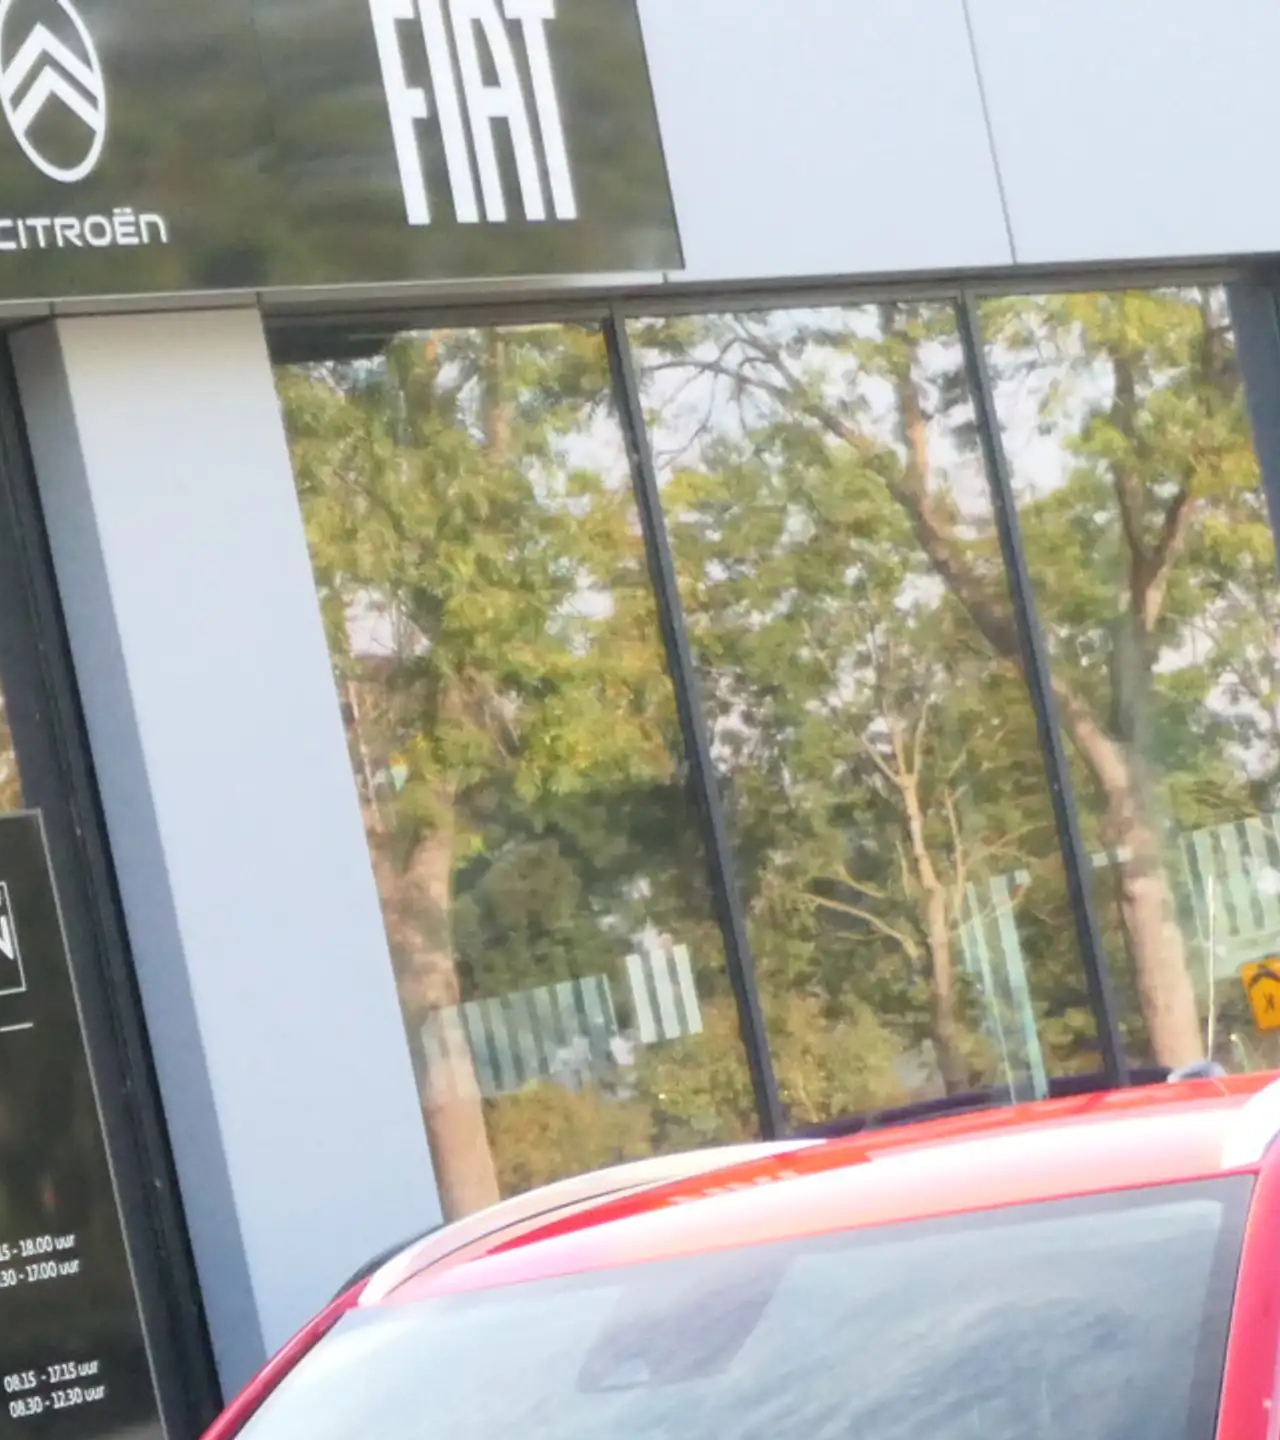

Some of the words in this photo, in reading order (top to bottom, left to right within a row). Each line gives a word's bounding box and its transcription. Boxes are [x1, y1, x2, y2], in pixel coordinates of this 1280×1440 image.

[368, 0, 577, 227] FIAT
[18, 1234, 54, 1258] 18.00
[24, 1260, 58, 1283] 17.00
[3, 1369, 38, 1393] 08.15
[8, 1395, 44, 1419] 08.30
